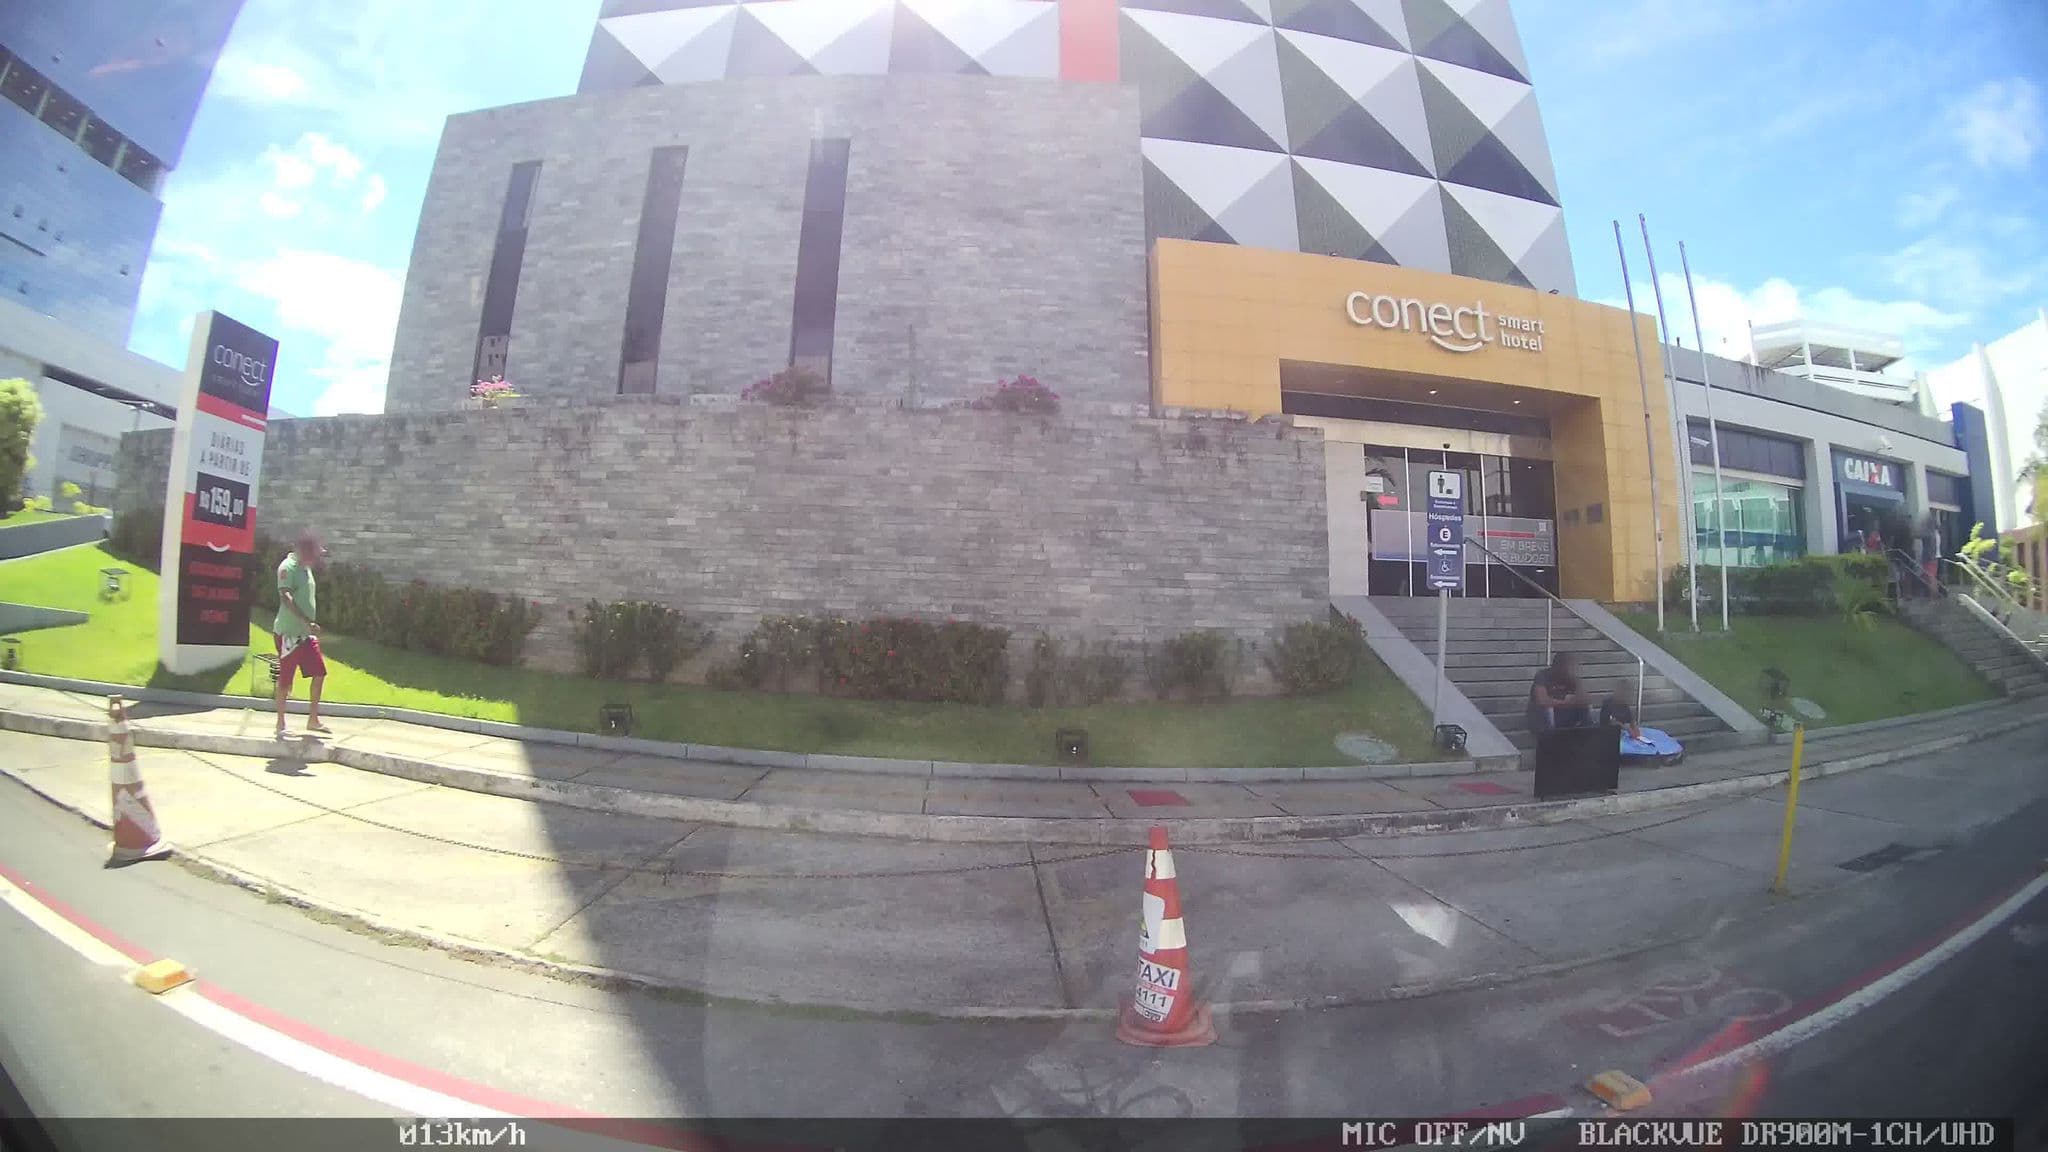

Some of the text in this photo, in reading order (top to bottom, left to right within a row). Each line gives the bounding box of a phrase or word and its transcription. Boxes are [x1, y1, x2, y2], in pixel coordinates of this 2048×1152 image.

[1346, 291, 1494, 343] conect
[1498, 313, 1544, 334] smart
[1500, 330, 1543, 351] hotel
[214, 344, 267, 382] conect
[1845, 457, 1891, 486] CAIXA
[1137, 960, 1175, 988] TAXI
